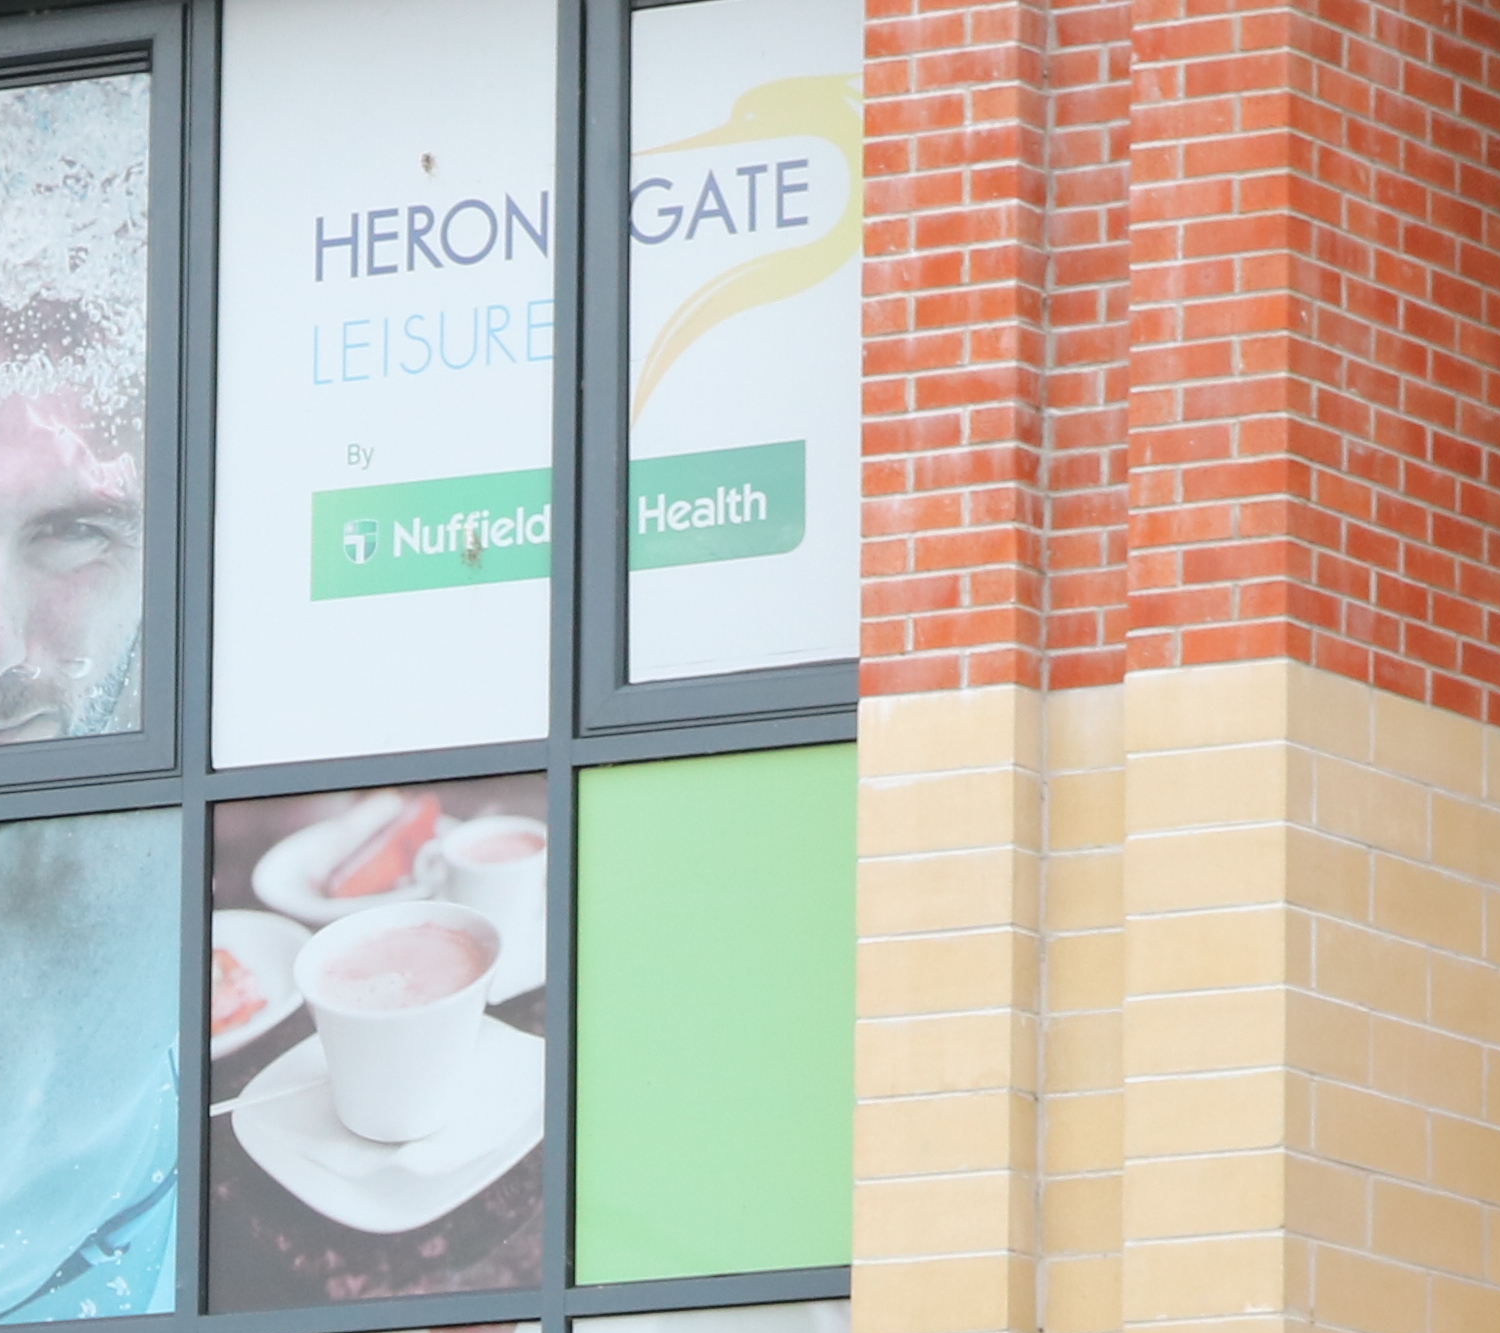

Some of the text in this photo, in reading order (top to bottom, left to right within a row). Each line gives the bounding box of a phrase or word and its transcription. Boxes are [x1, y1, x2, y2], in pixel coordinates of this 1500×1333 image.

[312, 298, 554, 386] LEISURE
[346, 443, 375, 470] By
[392, 482, 768, 559] Nuffield Health
